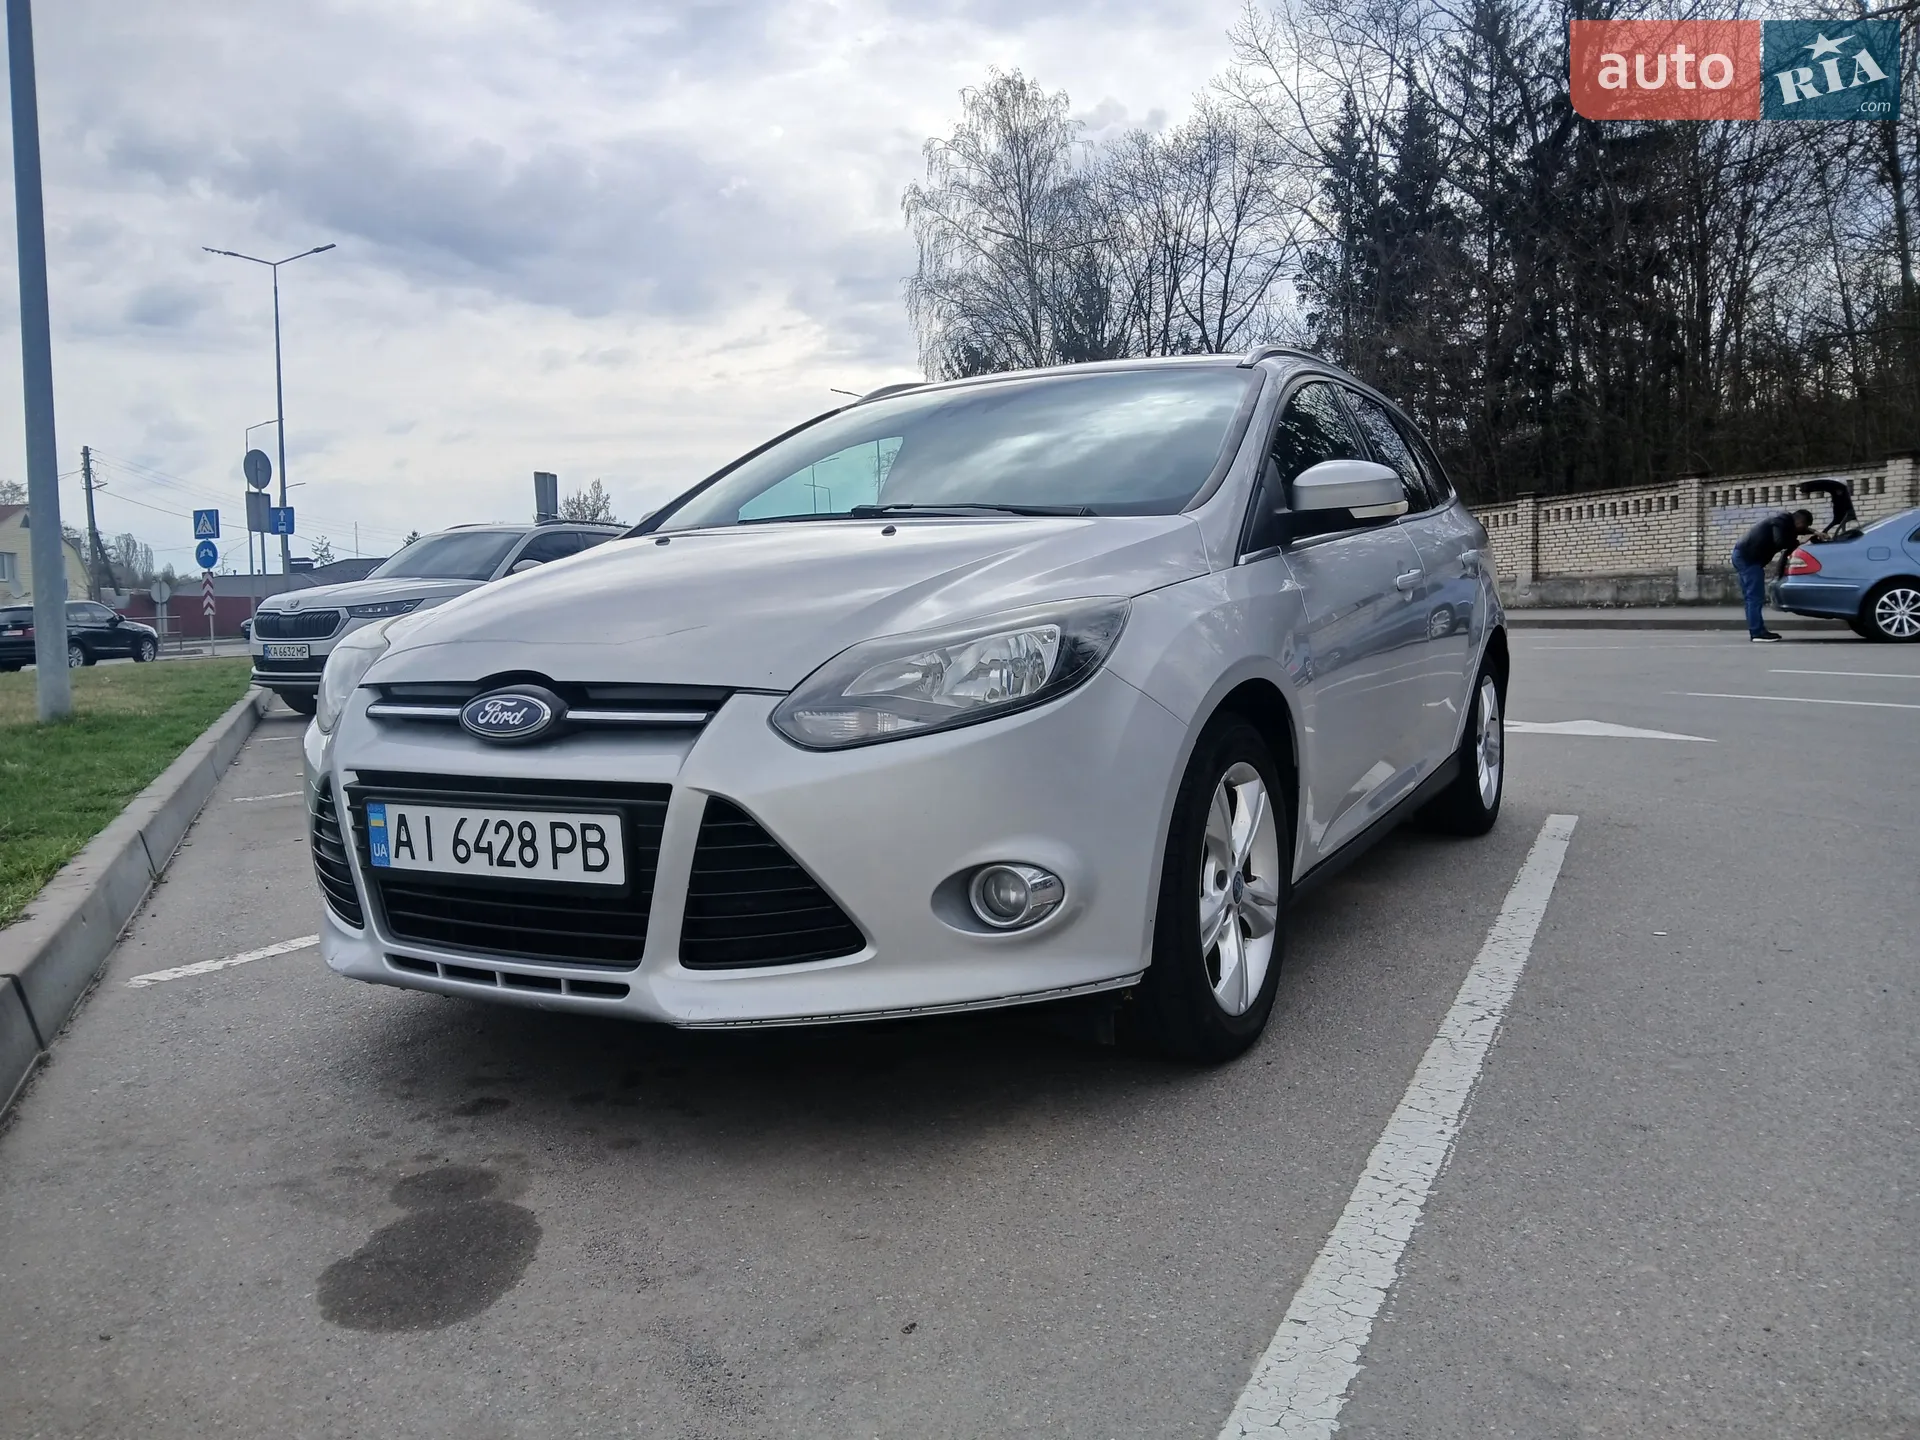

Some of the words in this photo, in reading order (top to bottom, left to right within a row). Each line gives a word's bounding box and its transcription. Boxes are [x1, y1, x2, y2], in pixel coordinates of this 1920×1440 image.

[477, 700, 529, 725] Ford
[373, 843, 388, 858] UA
[394, 813, 433, 861] AI
[452, 817, 539, 869] 6428
[549, 821, 610, 873] PB
